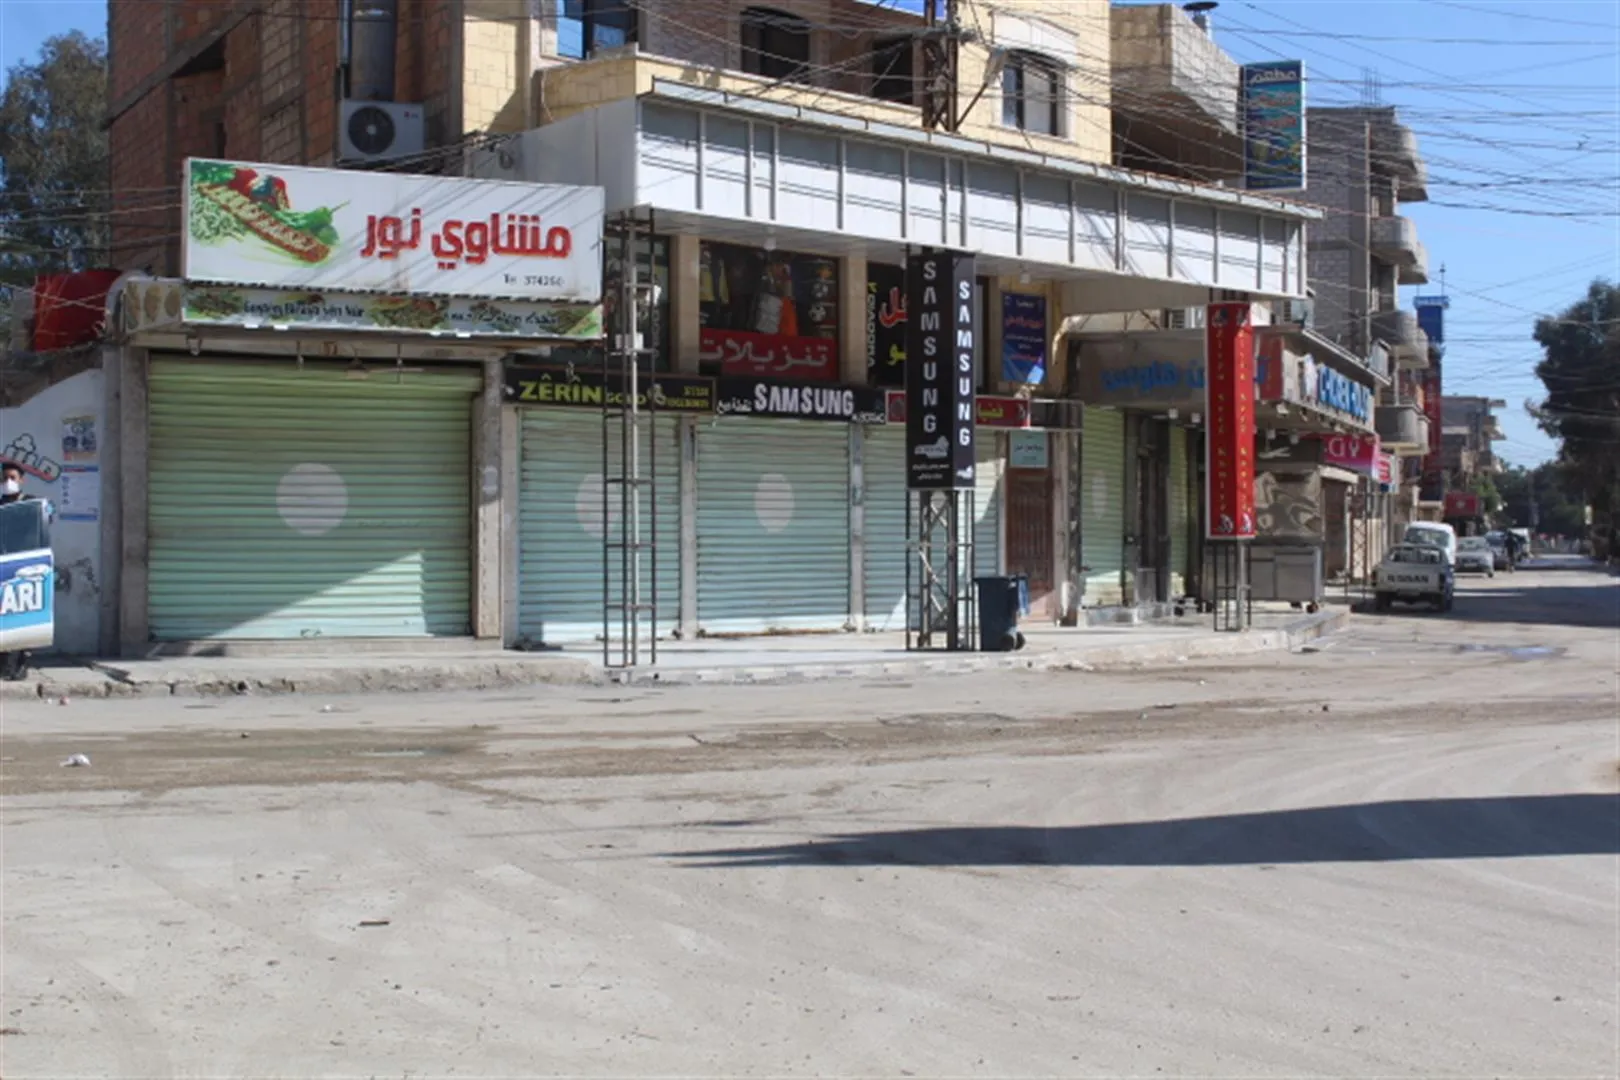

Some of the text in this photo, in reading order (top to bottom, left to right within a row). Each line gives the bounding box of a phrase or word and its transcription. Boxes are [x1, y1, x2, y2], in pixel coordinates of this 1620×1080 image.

[360, 207, 572, 270] مشاوي نور
[700, 337, 829, 372] تنزيلات
[920, 260, 941, 434] SAMSUNG
[957, 280, 973, 447] SAMSUNG
[754, 383, 855, 416] SAMSUNG
